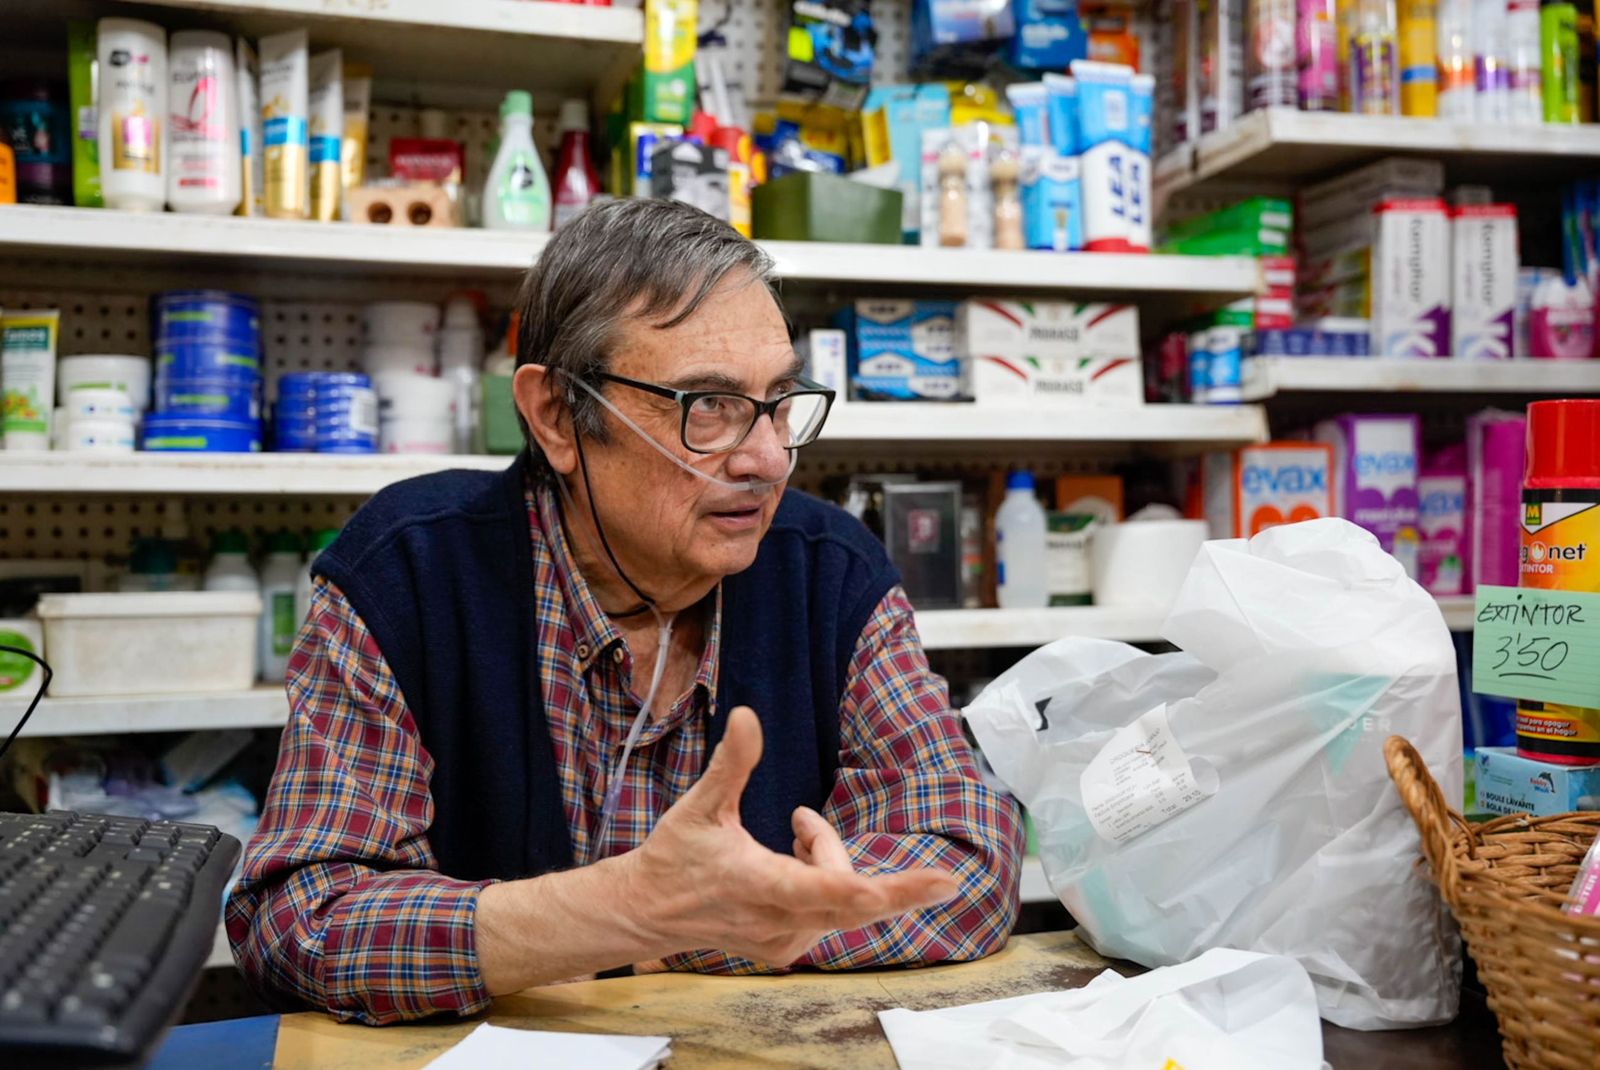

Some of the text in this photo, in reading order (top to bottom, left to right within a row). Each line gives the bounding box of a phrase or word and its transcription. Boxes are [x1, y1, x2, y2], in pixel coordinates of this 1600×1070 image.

[1355, 453, 1416, 476] evax
[1243, 464, 1325, 494] evax
[1418, 490, 1466, 517] vax
[1477, 594, 1585, 626] EXTINTOR
[1554, 727, 1577, 736] hogar
[1486, 791, 1535, 811] BOULE LAVANTE
